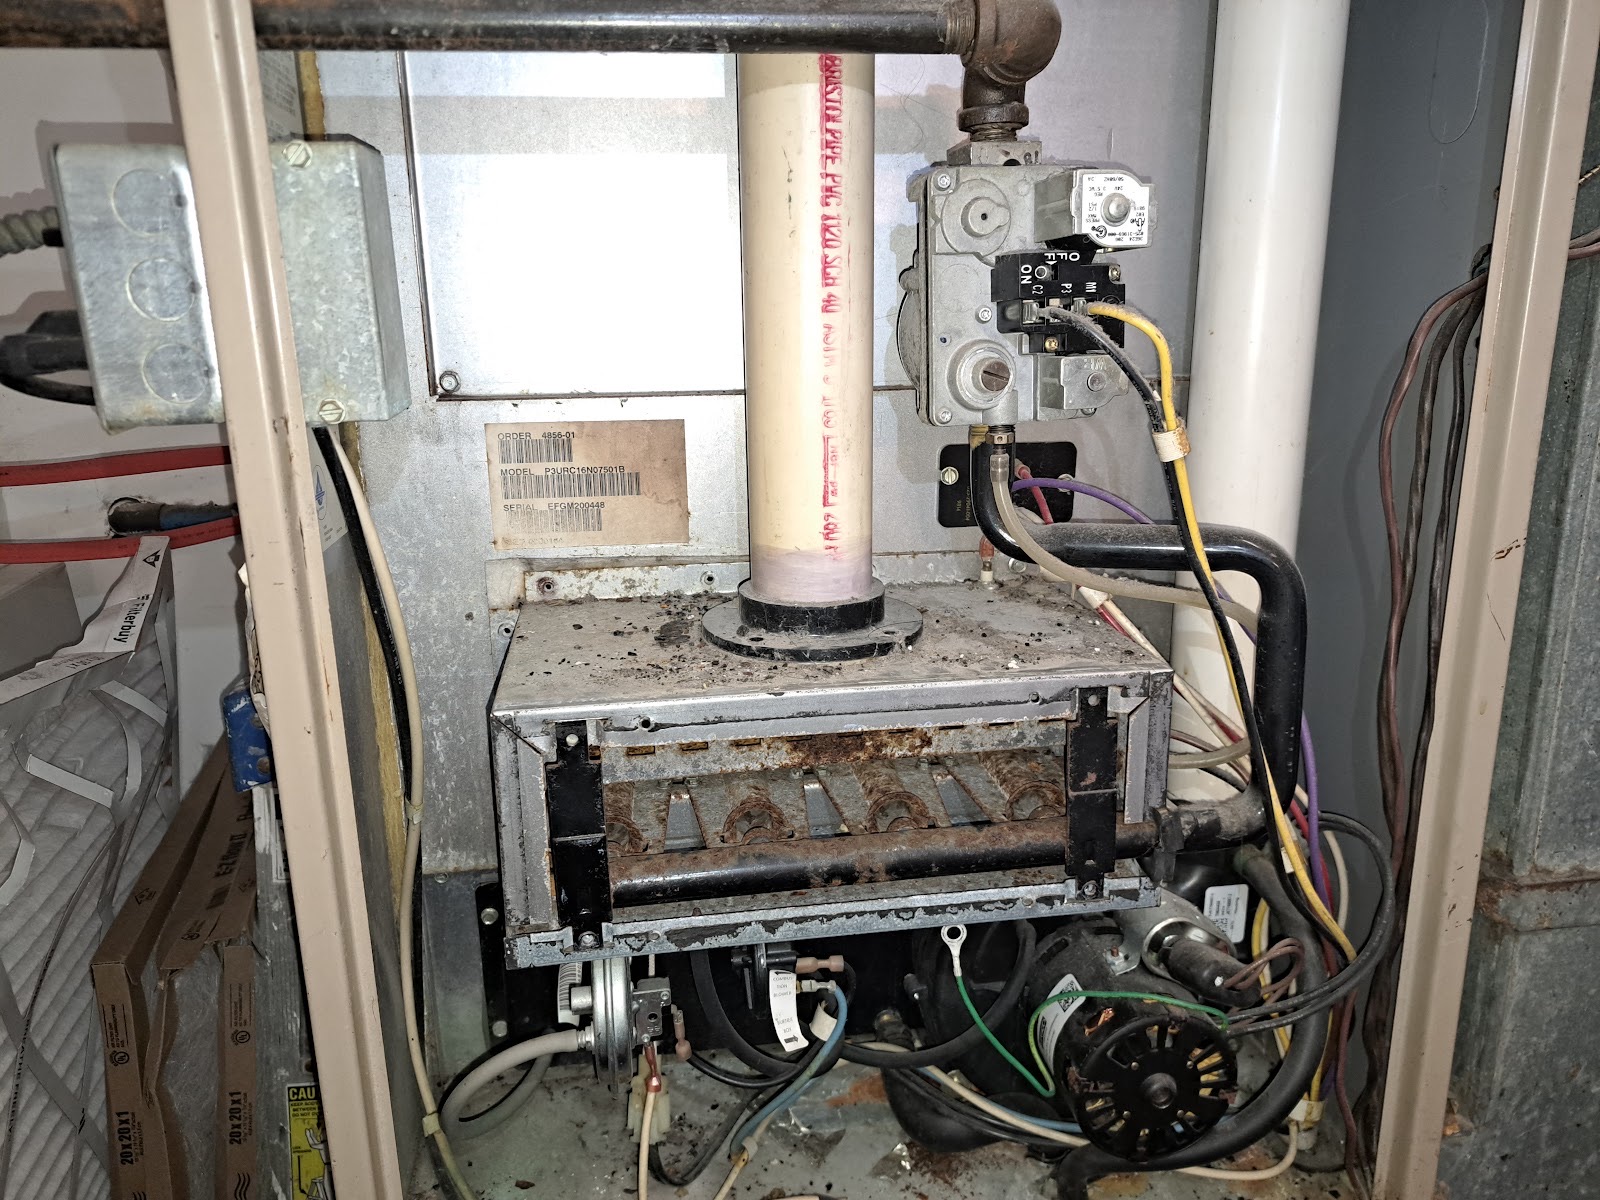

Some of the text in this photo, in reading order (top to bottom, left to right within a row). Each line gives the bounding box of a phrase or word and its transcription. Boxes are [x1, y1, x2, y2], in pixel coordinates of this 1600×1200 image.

[820, 171, 843, 207] PVC
[1043, 252, 1080, 262] OFF
[820, 253, 842, 288] SCH
[1020, 264, 1033, 285] ON
[1032, 284, 1044, 295] C2
[1061, 283, 1073, 294] P3
[497, 431, 576, 440] ORDER 4856-01
[500, 468, 535, 476] MODEL
[503, 504, 537, 512] SERIAL
[113, 603, 144, 643] Filterbuy
[289, 1087, 315, 1100] CAU
